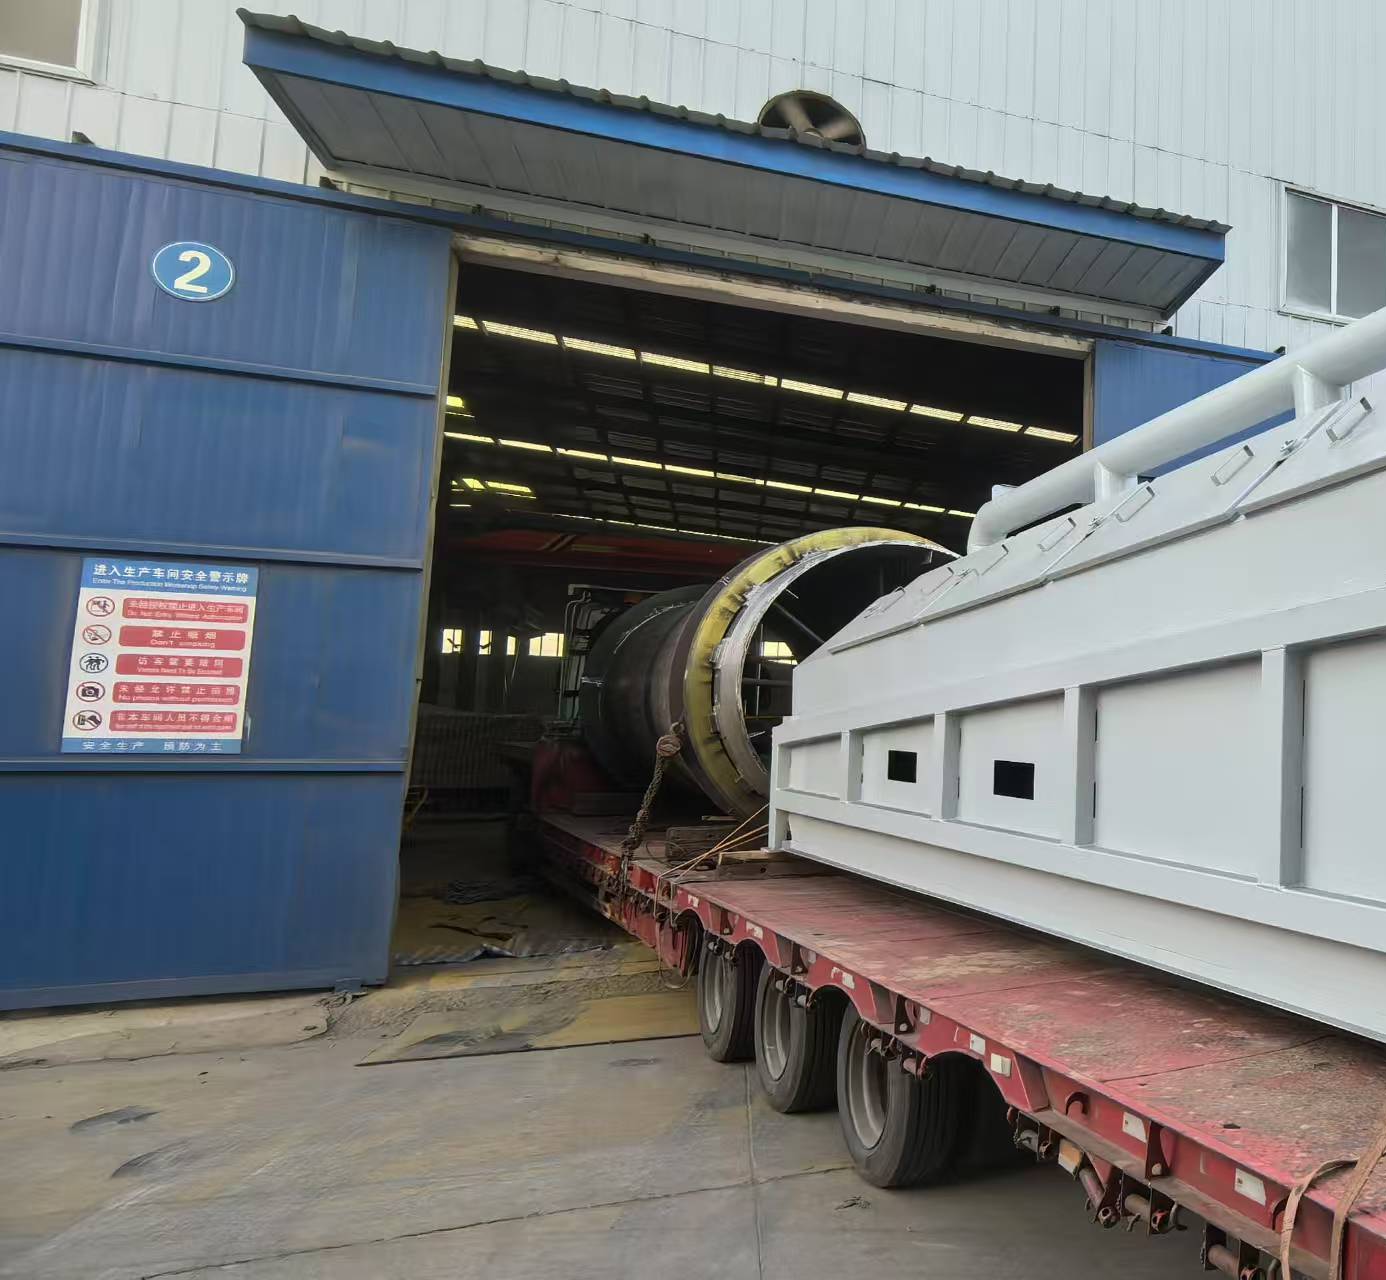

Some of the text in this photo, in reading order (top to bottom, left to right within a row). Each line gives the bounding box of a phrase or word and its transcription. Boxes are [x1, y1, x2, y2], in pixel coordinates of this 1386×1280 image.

[174, 250, 210, 293] 2
[93, 564, 248, 584] 进入生产车间安全警示牌
[151, 629, 217, 640] 禁止吸烟
[82, 741, 222, 751] 安全生产 预防为主
